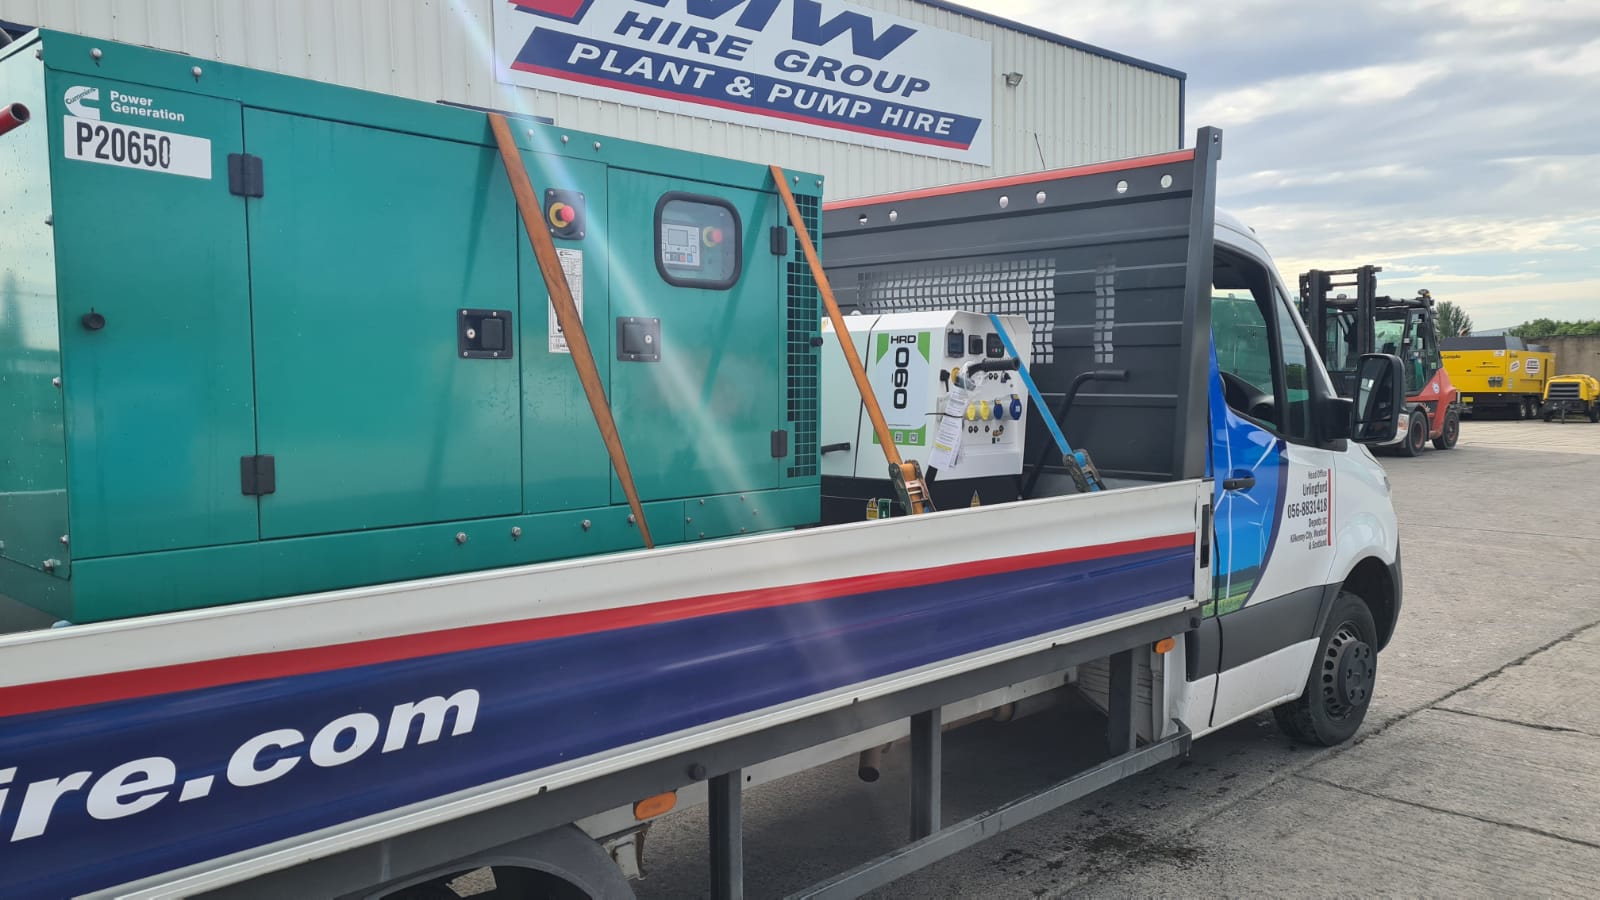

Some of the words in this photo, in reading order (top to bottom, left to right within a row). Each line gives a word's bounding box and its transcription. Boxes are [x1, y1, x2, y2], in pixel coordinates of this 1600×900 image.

[613, 10, 754, 61] HIRE
[773, 49, 931, 98] GROUP
[110, 90, 153, 107] Power
[567, 42, 716, 89] PLANT
[724, 76, 755, 98] &
[767, 83, 872, 118] PUMP
[880, 106, 955, 135] HIRE
[110, 101, 185, 122] Generation
[76, 121, 171, 169] P20650
[890, 335, 917, 344] HRD
[1287, 497, 1327, 519] 056-8831418
